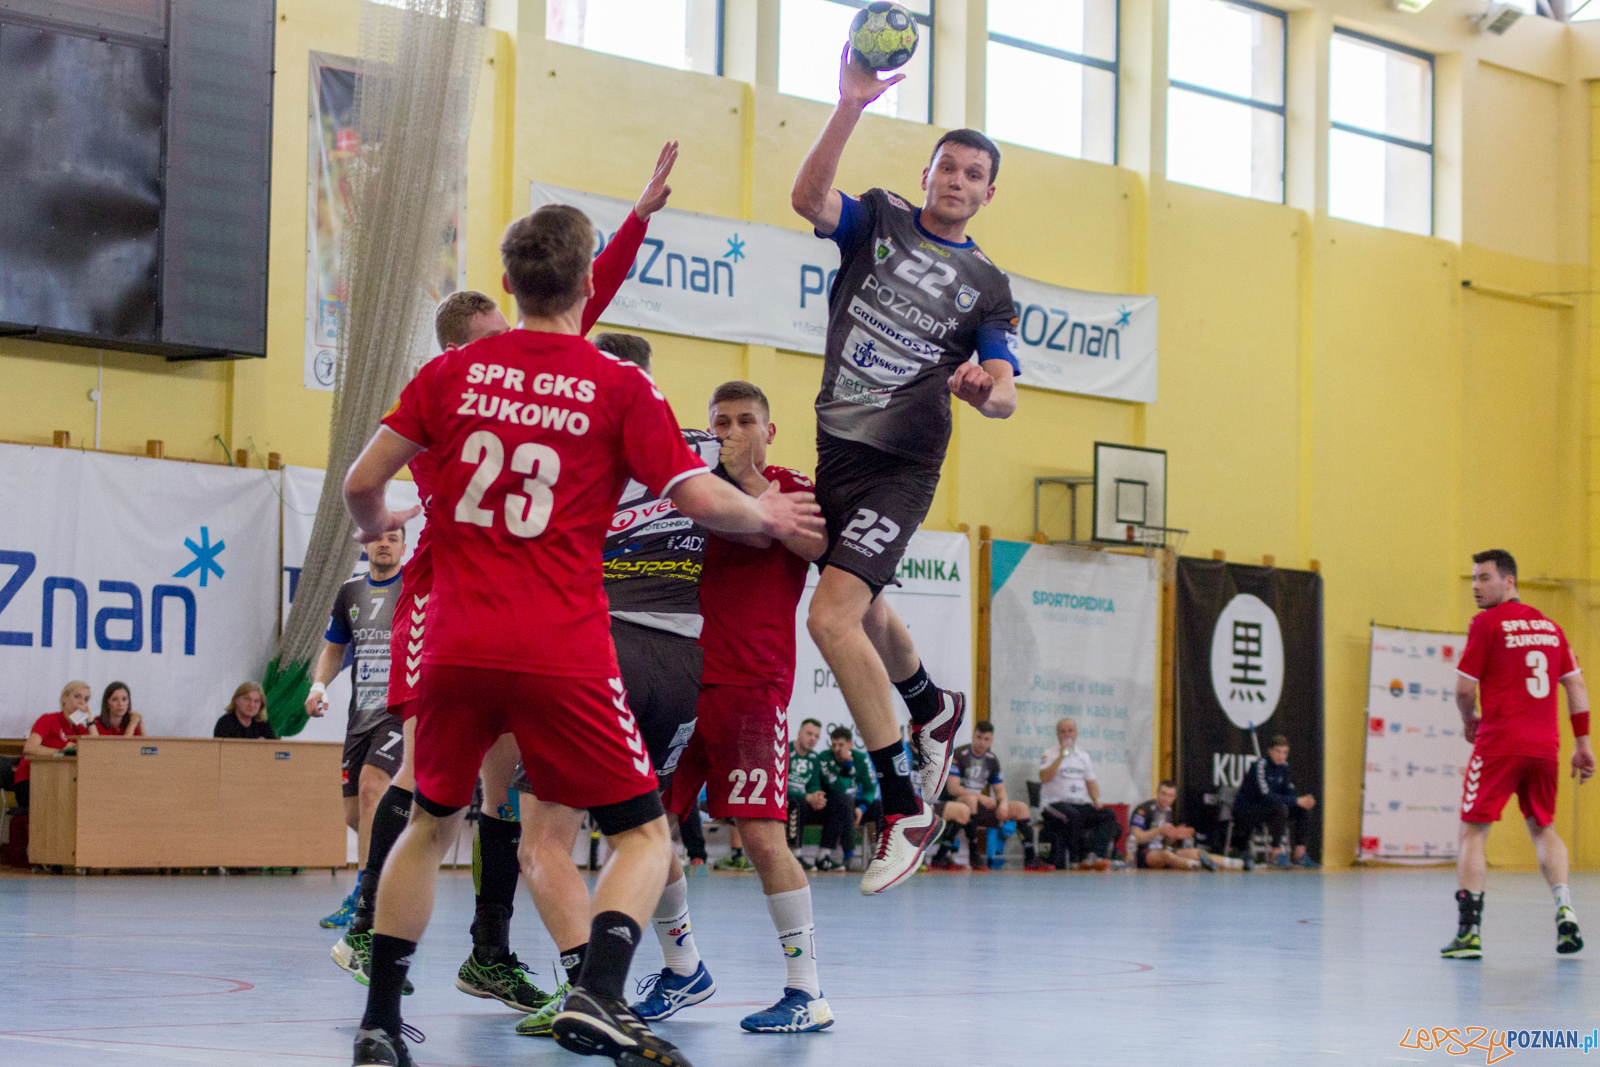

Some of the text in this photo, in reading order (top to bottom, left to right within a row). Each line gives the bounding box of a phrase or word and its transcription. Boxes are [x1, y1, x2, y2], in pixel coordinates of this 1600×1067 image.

[893, 249, 958, 299] 22
[853, 305, 921, 352] GRUNDFOS
[466, 362, 597, 403] SPR GKS
[457, 387, 590, 436] ŻUKOWO
[454, 430, 561, 539] 23
[840, 508, 901, 555] 22
[368, 597, 386, 620] 7
[1501, 620, 1530, 632] SPR
[1504, 633, 1560, 649] ŻUKOWO
[1524, 650, 1551, 699] 3
[379, 730, 403, 752] 7
[727, 768, 769, 805] 22
